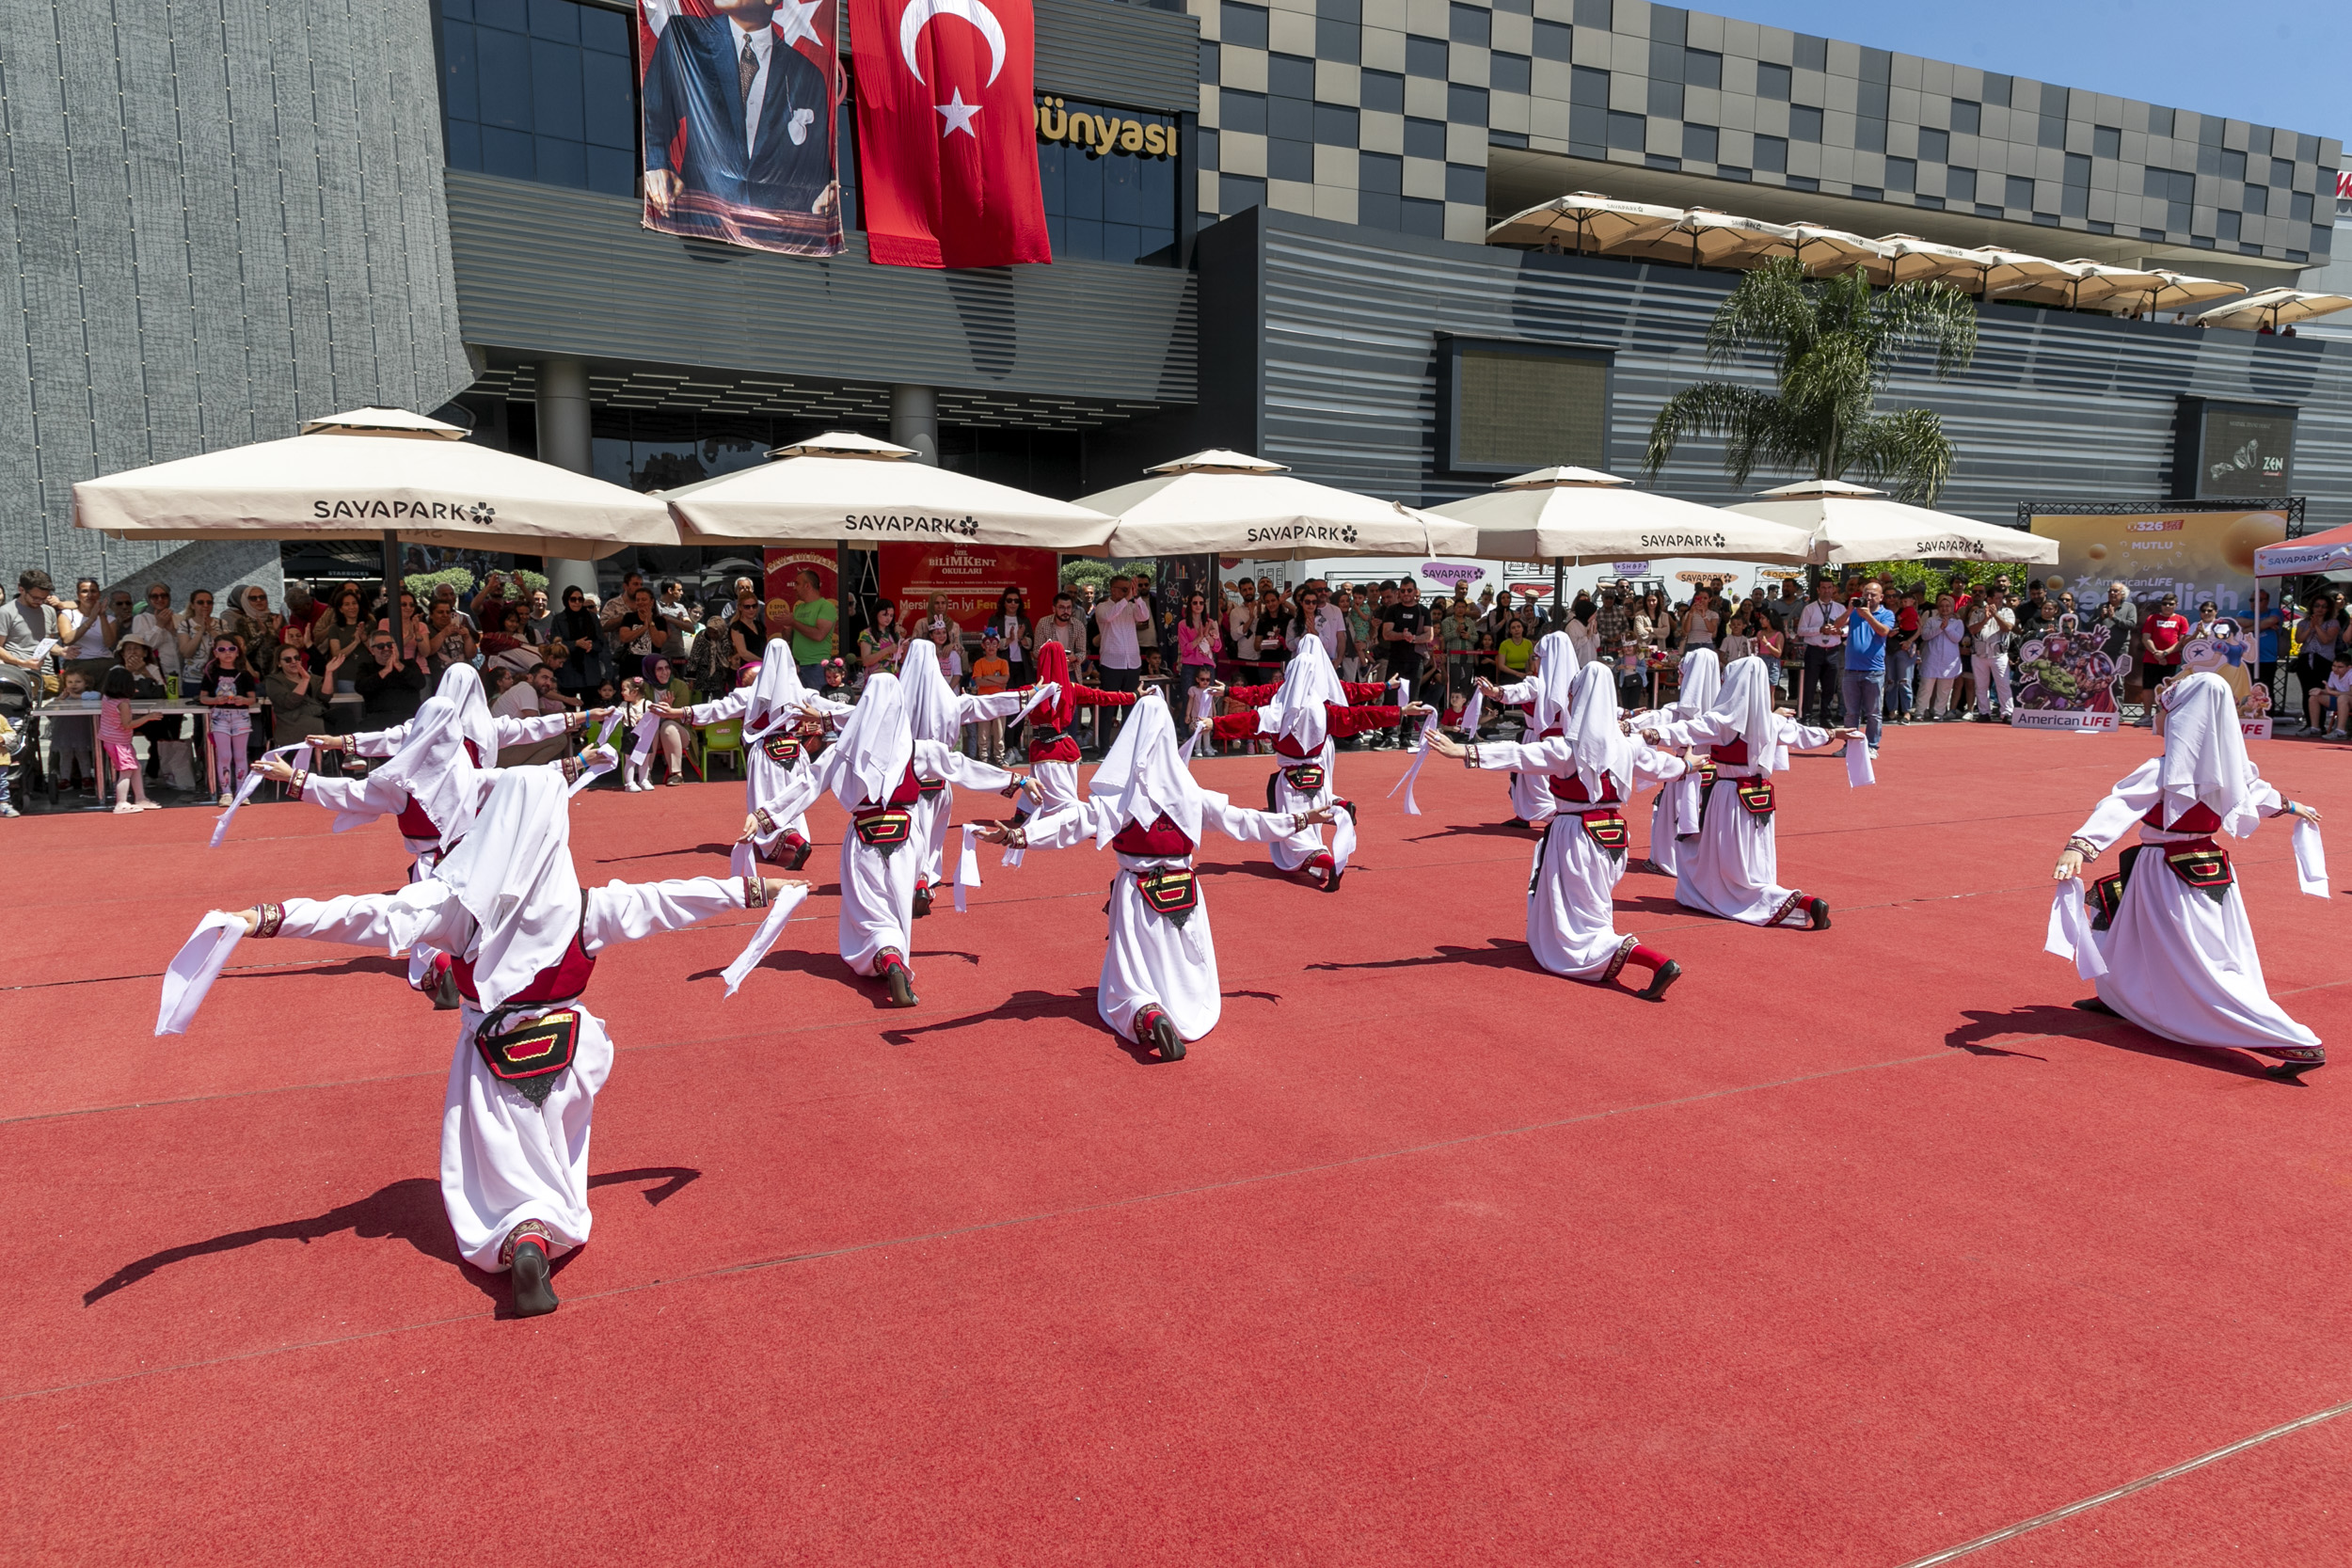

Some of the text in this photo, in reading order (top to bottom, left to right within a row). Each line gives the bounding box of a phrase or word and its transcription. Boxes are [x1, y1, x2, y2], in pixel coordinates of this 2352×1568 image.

[1035, 96, 1178, 157] ünyası
[2263, 456, 2283, 470] ZEN
[314, 500, 467, 521] SAYAPARK
[845, 515, 957, 533] SAYAPARK
[2137, 521, 2164, 531] 326
[1248, 525, 1340, 542] SAYAPARK
[1641, 534, 1713, 547] SAYAPARK
[1916, 540, 1973, 553] SAYAPARK
[2132, 541, 2173, 549] MUTLU
[954, 547, 968, 556] ÖZEL
[2268, 554, 2320, 565] SAYAPARK
[1422, 569, 1473, 578] SAYAPARK
[961, 596, 975, 612] İyi
[2017, 713, 2112, 727] American LIFE
[2241, 723, 2265, 735] IFE
